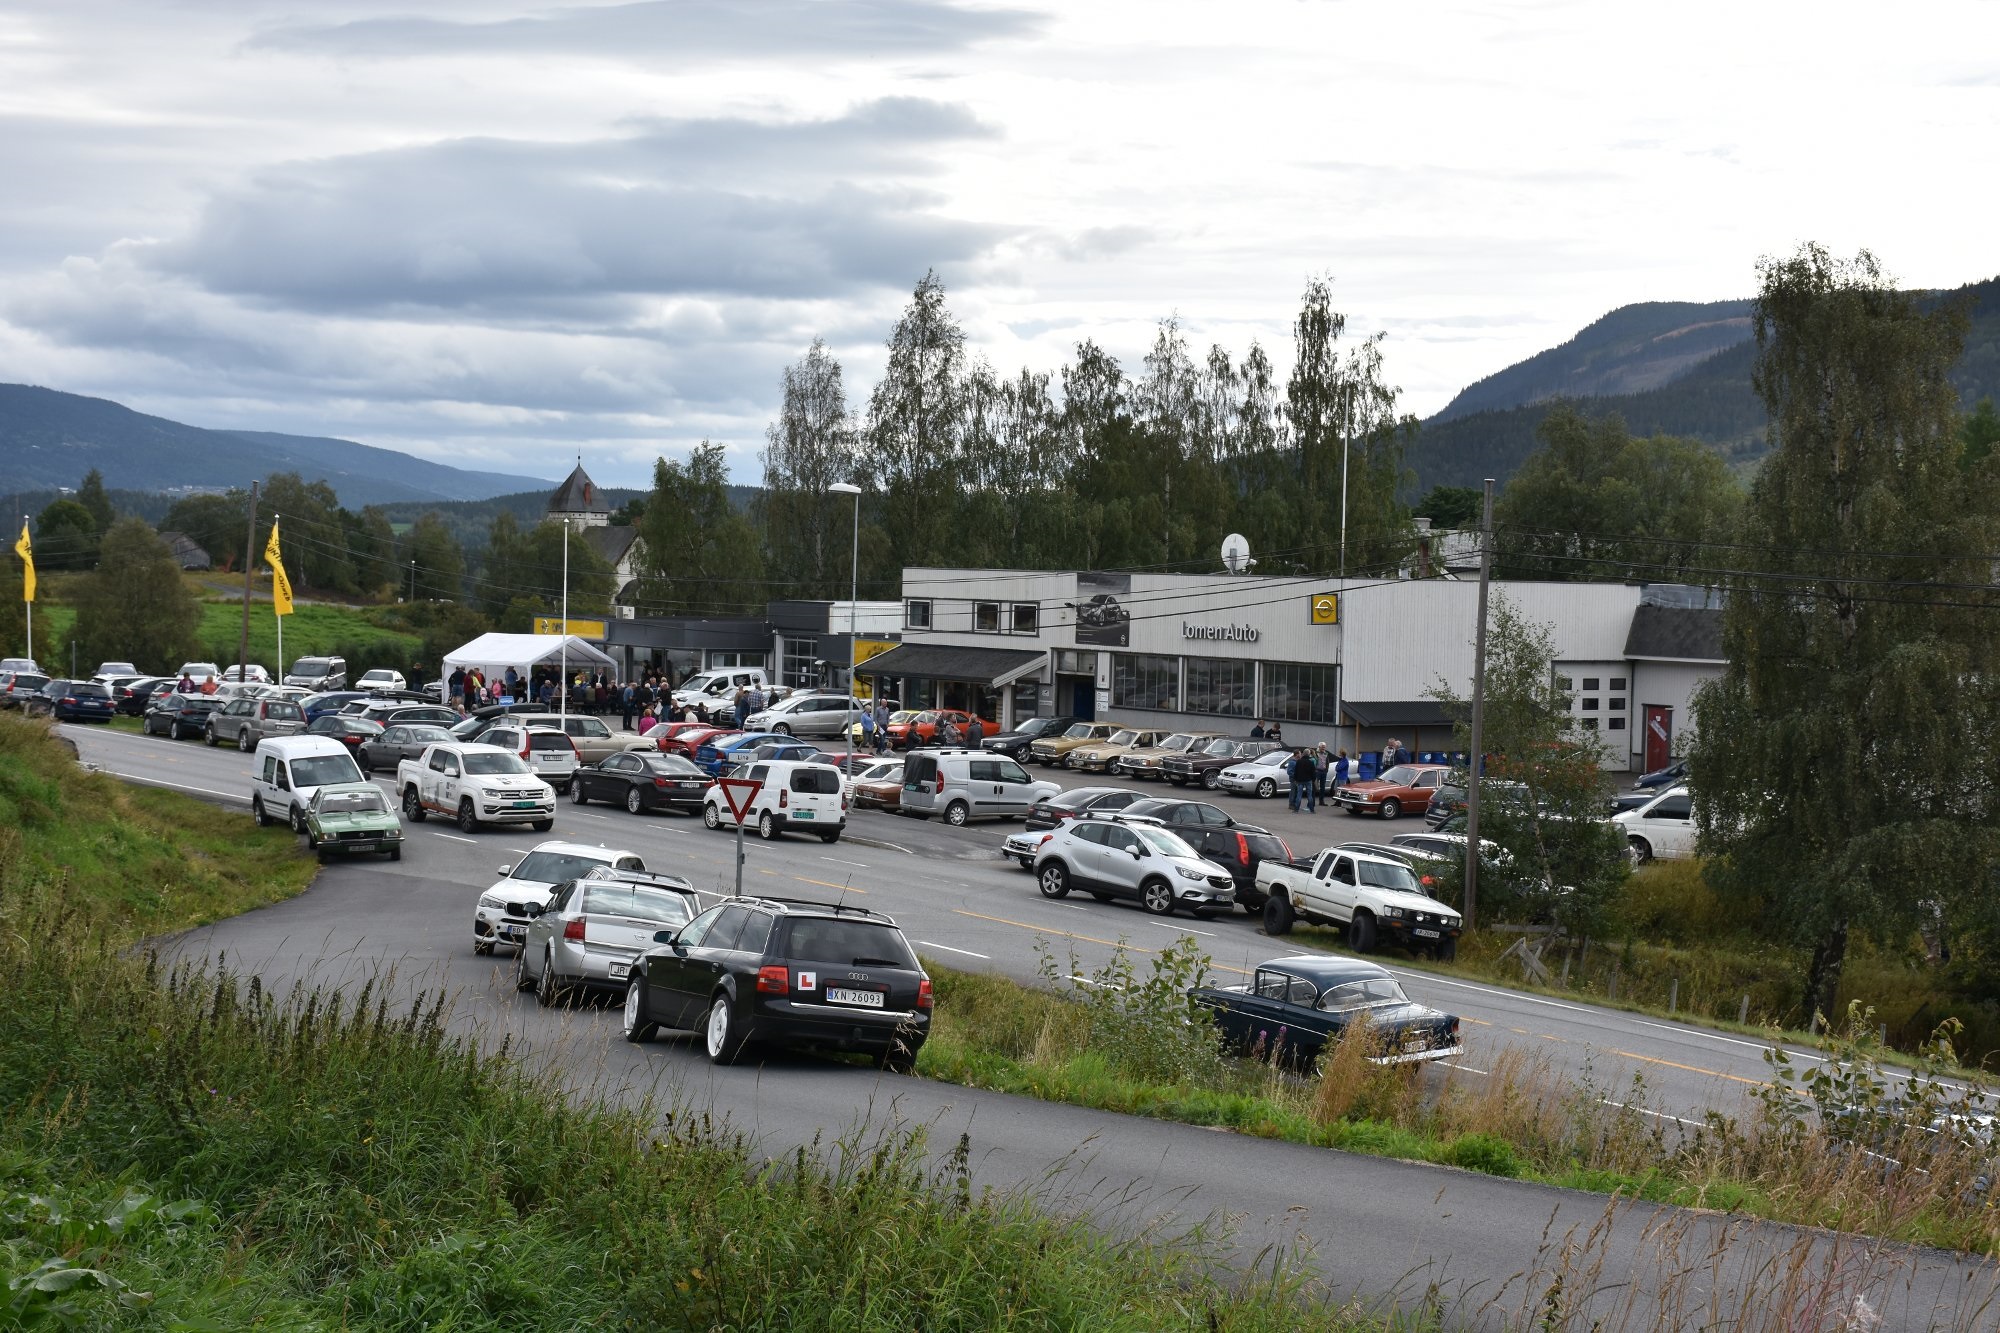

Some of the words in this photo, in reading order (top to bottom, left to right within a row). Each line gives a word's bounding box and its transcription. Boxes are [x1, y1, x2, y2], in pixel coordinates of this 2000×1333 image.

[1181, 620, 1222, 640] Lomen
[1223, 622, 1259, 642] Auto
[801, 974, 813, 988] L
[833, 990, 847, 1001] XN
[851, 992, 881, 1004] 26093
